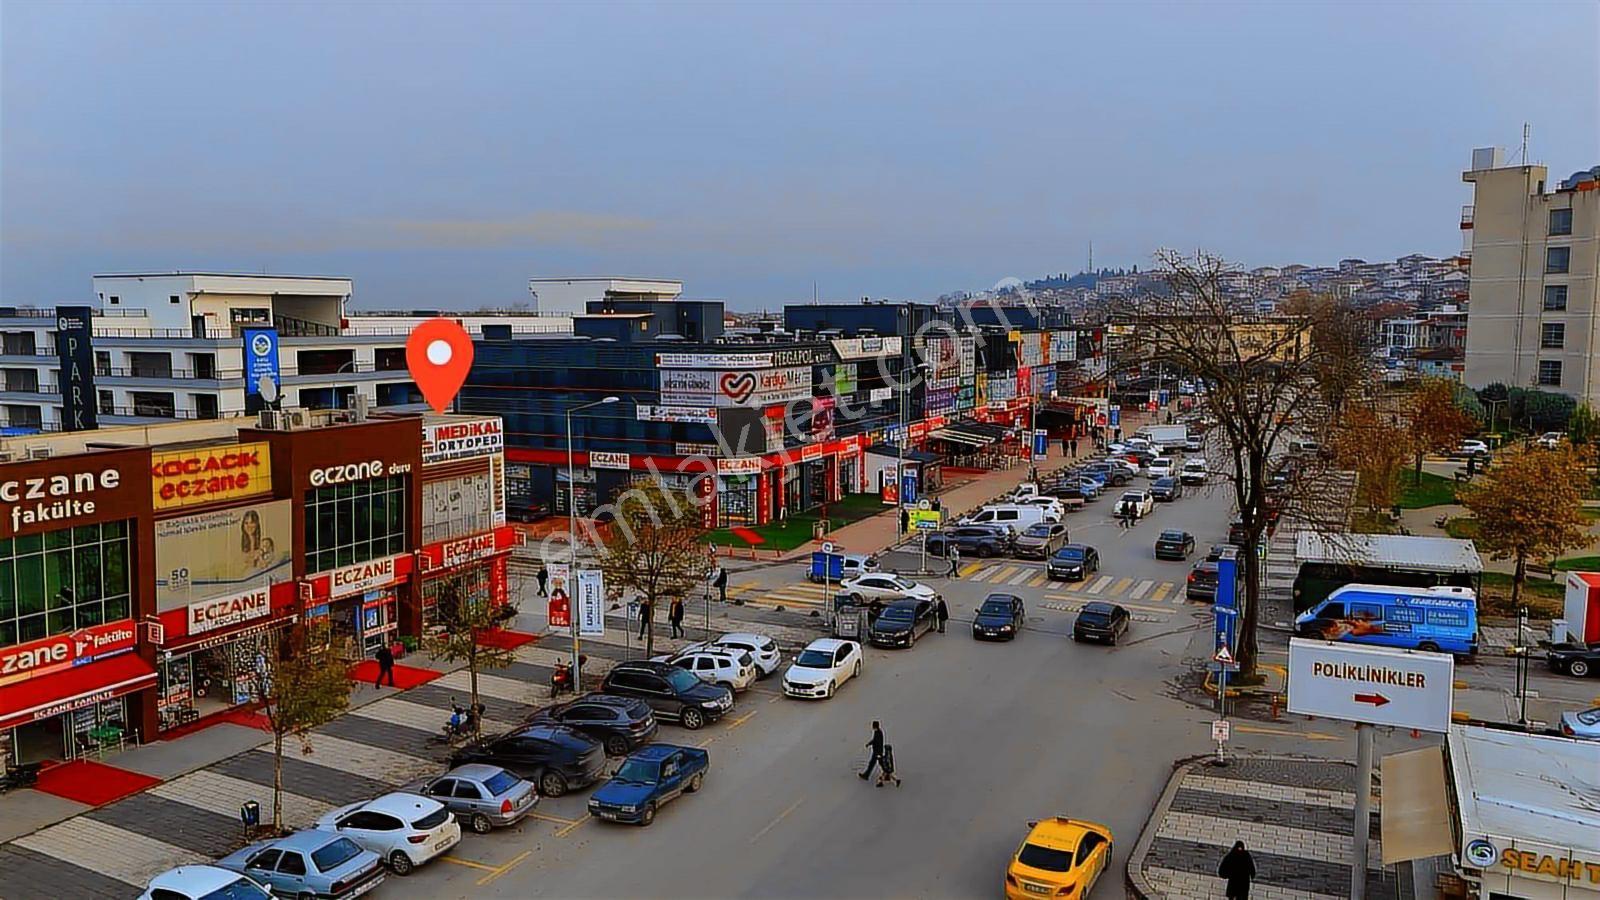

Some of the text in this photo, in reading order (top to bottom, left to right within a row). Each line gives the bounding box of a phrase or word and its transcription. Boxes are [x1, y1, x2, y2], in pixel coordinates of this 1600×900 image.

[68, 337, 85, 430] PARK
[438, 421, 501, 441] MEDİKAL
[591, 452, 628, 464] ECZANE
[160, 472, 249, 500] eczane
[310, 460, 412, 487] eczane duru
[11, 499, 96, 533] fakülte
[447, 535, 494, 558] ECZANE
[171, 568, 189, 581] 50
[334, 560, 392, 587] ECZANE
[193, 592, 266, 623] ECZANE
[94, 629, 133, 649] fakülte
[1313, 661, 1426, 689] POLİKLİNİKLER
